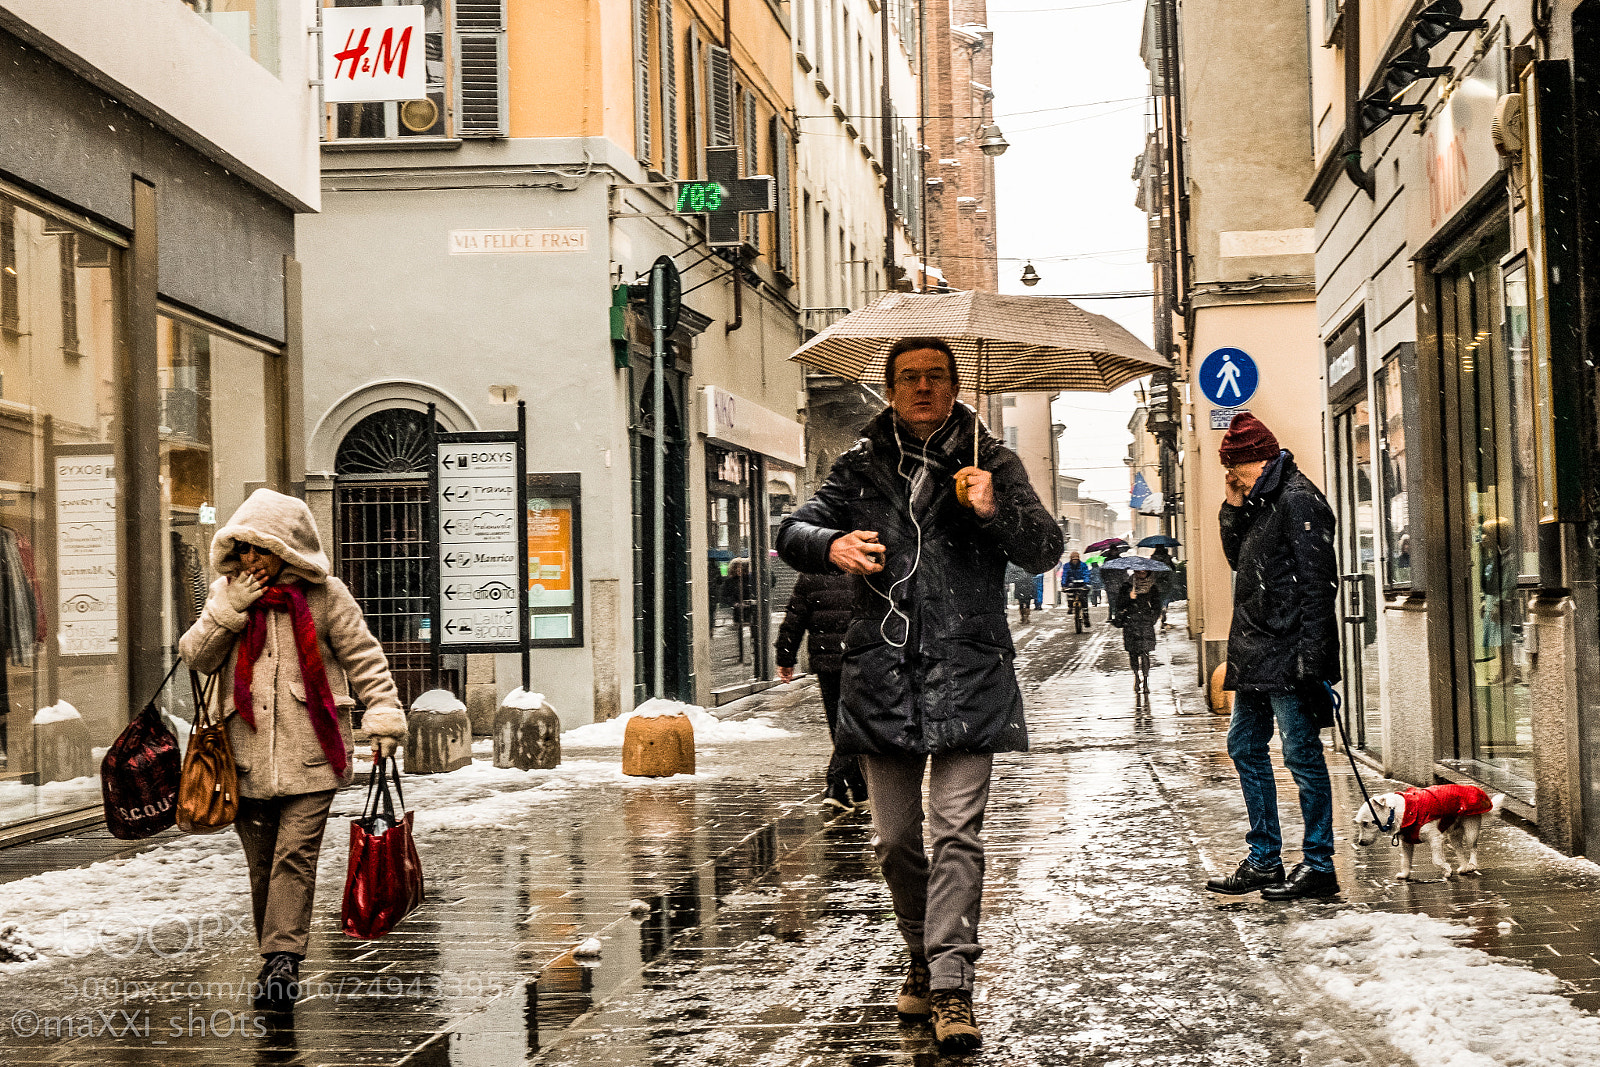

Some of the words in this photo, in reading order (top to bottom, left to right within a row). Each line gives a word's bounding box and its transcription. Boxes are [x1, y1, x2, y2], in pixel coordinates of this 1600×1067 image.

[333, 26, 413, 80] H&M
[454, 235, 478, 249] VIA
[484, 234, 533, 248] FELICE
[541, 233, 584, 247] FRASI
[471, 452, 513, 463] BOXYS
[472, 486, 513, 496] Tramp
[473, 553, 514, 563] Manrico
